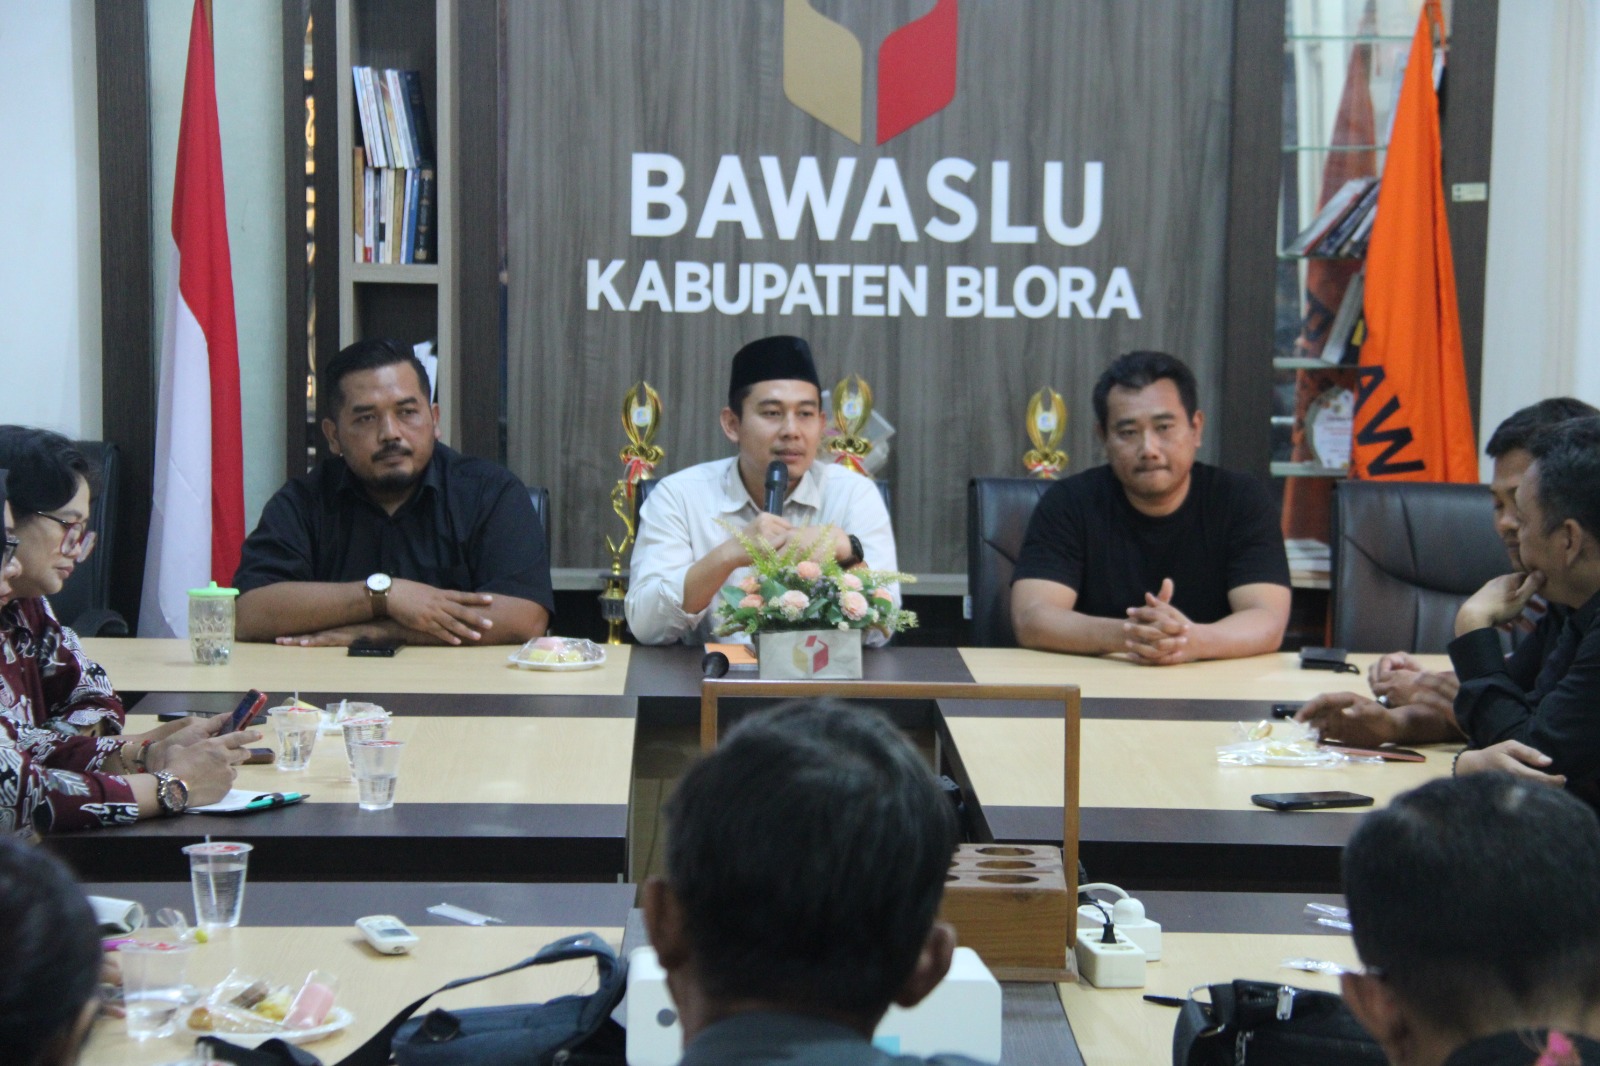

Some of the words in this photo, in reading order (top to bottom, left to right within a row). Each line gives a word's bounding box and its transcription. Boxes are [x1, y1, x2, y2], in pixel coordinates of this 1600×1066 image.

[630, 152, 1103, 247] BAWASLU
[586, 259, 928, 317] KABUPATEN
[945, 265, 1142, 320] BLORA
